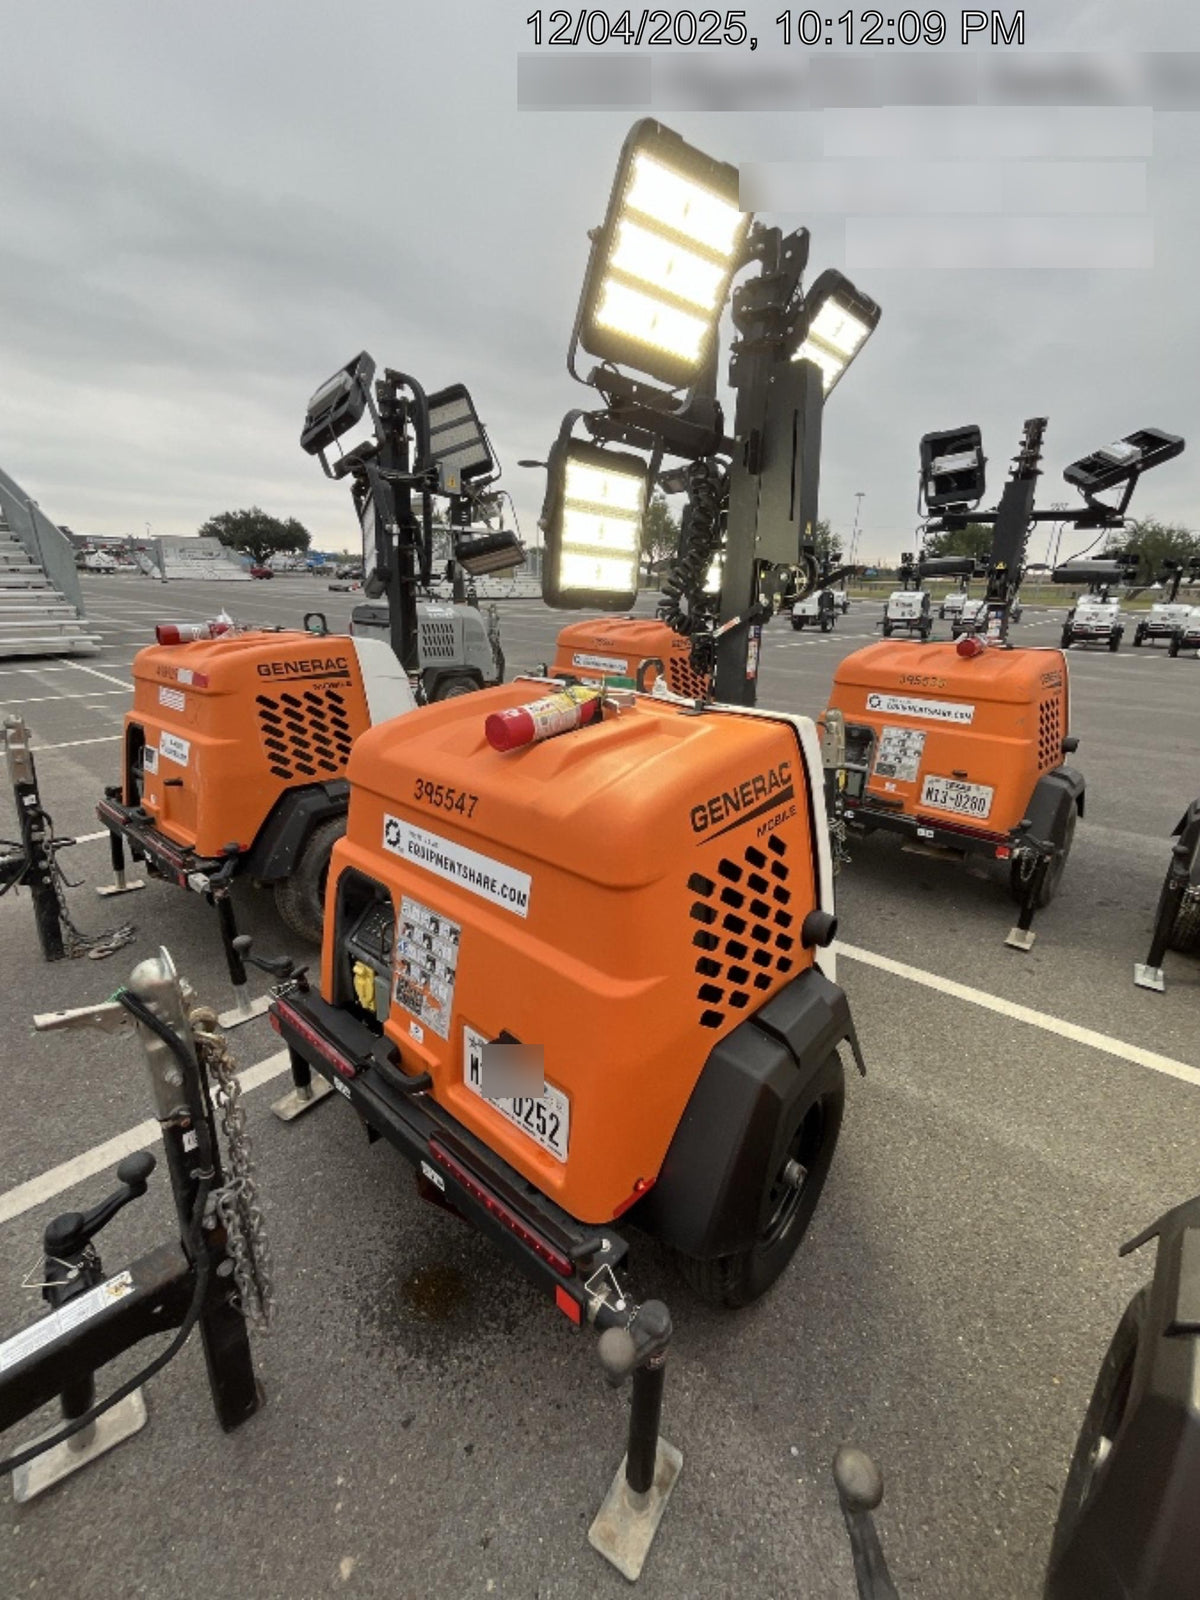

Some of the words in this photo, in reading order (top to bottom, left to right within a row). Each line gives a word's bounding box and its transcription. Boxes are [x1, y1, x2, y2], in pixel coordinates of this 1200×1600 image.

[257, 657, 349, 676] GENERAC
[413, 778, 479, 818] 395547
[690, 761, 792, 833] GENERAC
[756, 804, 797, 838] MOBILE
[407, 839, 528, 908] EQUIPMENTSHARE.COM
